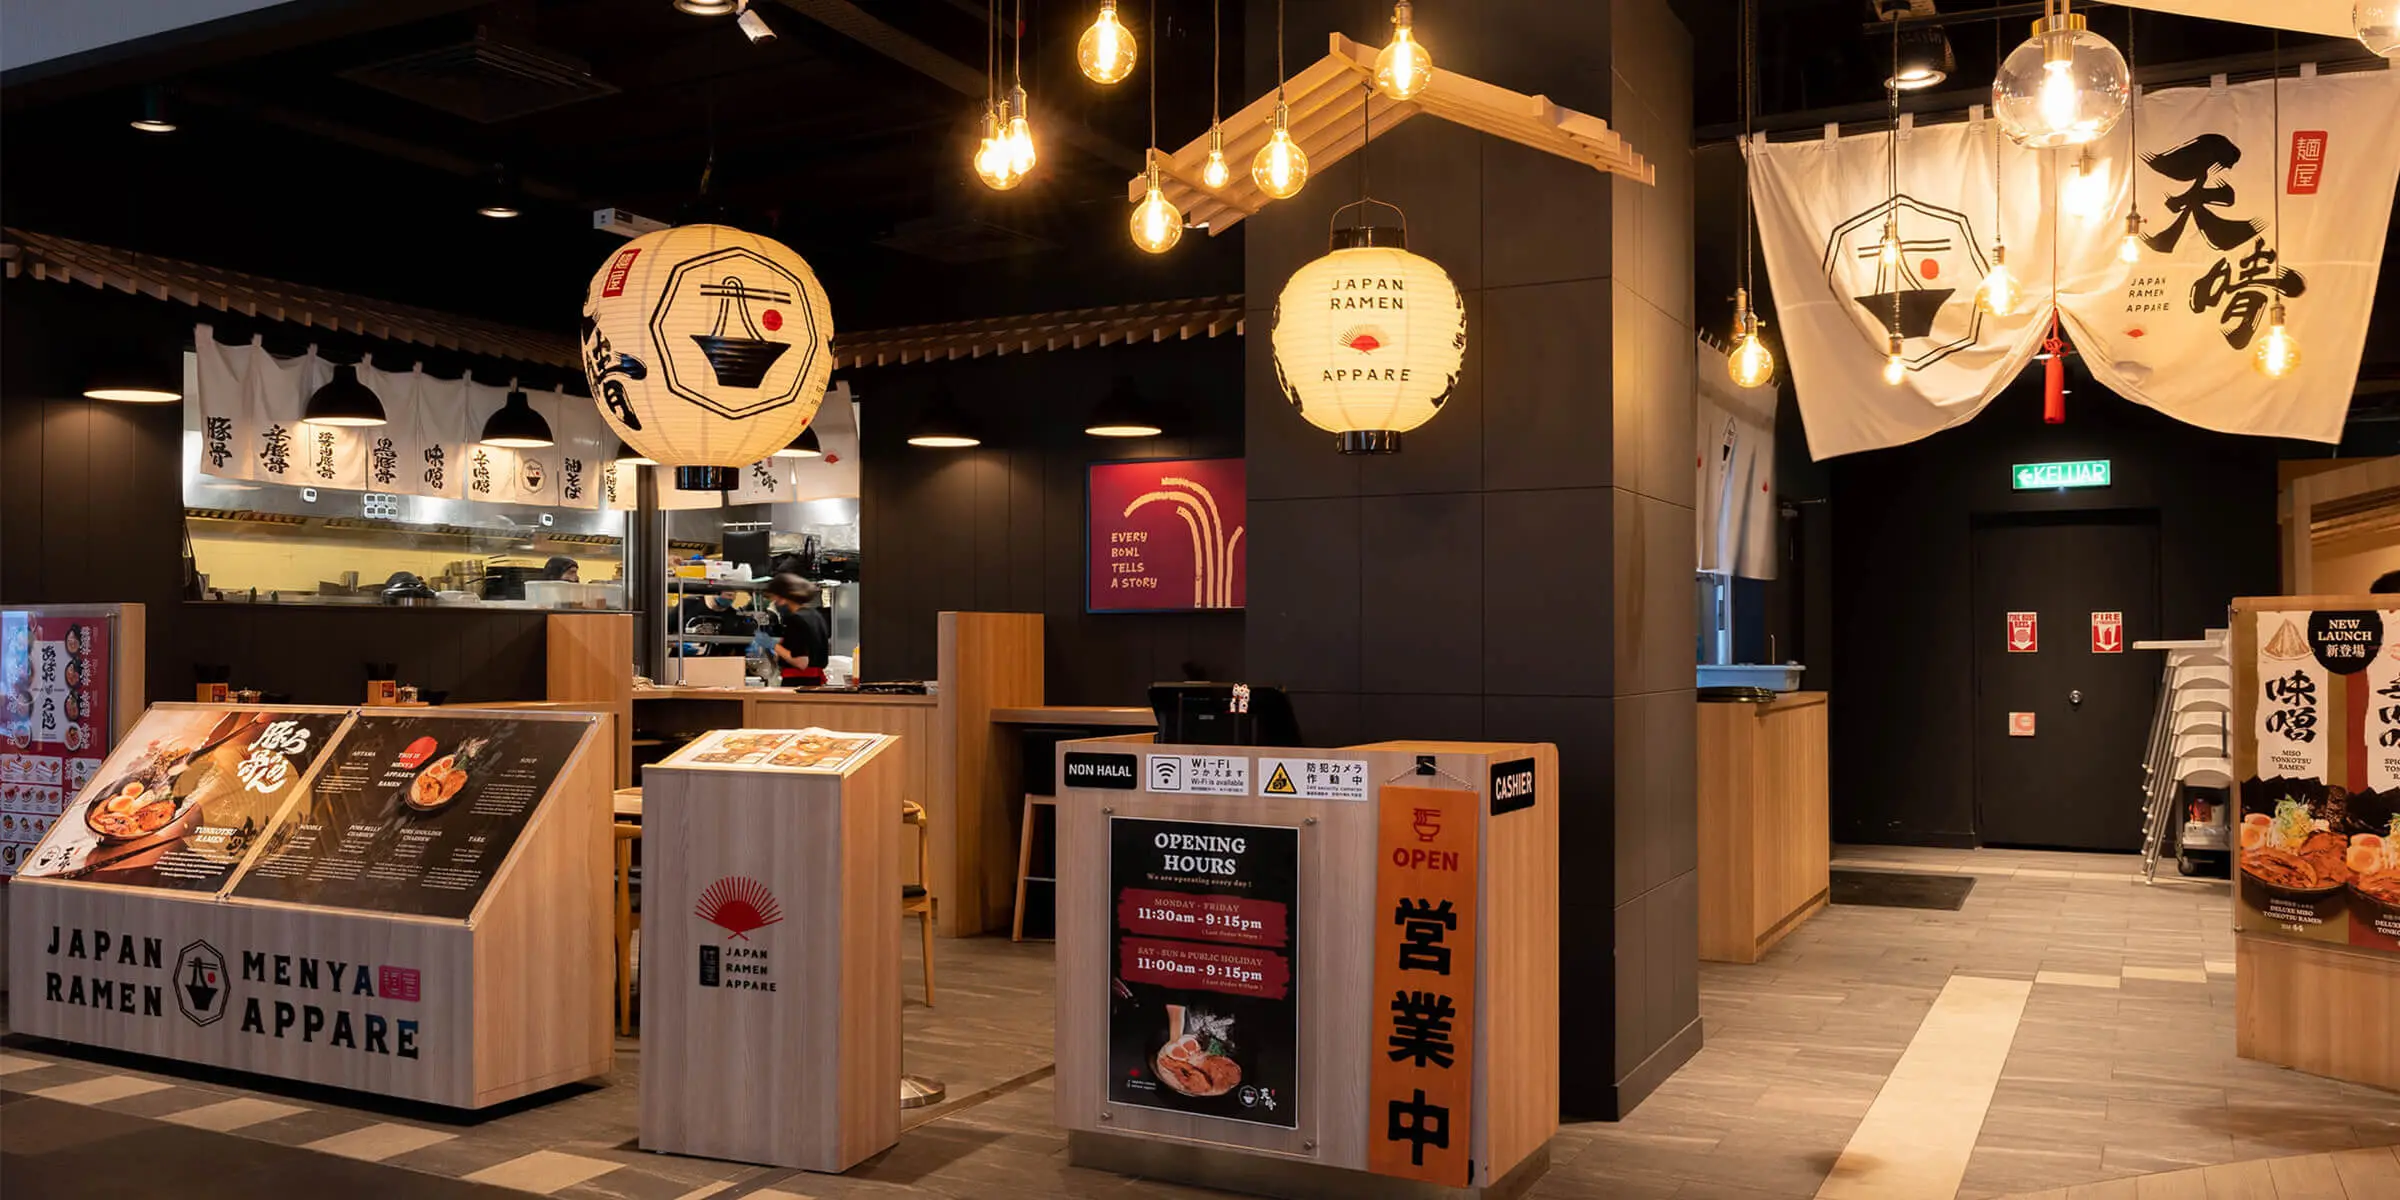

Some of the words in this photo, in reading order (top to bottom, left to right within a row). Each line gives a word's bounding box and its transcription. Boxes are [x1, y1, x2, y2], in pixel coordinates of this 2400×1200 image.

[1332, 278, 1405, 291] JAPAN
[2131, 277, 2166, 286] JAPAN
[2128, 289, 2164, 298] RAMEN
[1330, 297, 1404, 310] RAMEN
[2126, 303, 2170, 313] APPARE
[1322, 368, 1412, 382] APPARE
[207, 416, 232, 468] 豚骨
[2033, 464, 2106, 484] KELUAR
[1111, 531, 1148, 543] EVERY
[1111, 547, 1140, 558] BOWL
[1111, 562, 1145, 573] TELLS
[1110, 578, 1118, 589] A
[1121, 577, 1158, 589] STORY
[2328, 619, 2360, 630] NEW
[2317, 631, 2372, 641] LAUNCH
[2326, 644, 2366, 658] 新登場
[2264, 669, 2317, 743] 味噌
[1191, 758, 1230, 769] Wi-Fi
[2270, 756, 2312, 765] TONKOTSU
[1068, 764, 1094, 776] NON
[1097, 765, 1132, 777] HALAL
[1306, 762, 1362, 774] 防犯カメラ
[1495, 771, 1533, 800] CASHIER
[1154, 832, 1246, 854] OPENING
[1164, 854, 1237, 876] HOURS
[1392, 847, 1459, 872] OPEN
[1154, 898, 1196, 910] MONDAY
[1204, 902, 1240, 912] FRIDAY
[1138, 908, 1196, 923] 11:30am
[47, 926, 163, 969] JAPAN
[726, 946, 768, 959] JAPAN
[1188, 951, 1220, 962] PUBLIC
[1221, 955, 1264, 966] HOLIDAY
[726, 963, 768, 975] RAMEN
[1137, 958, 1196, 974] 11:00am
[242, 950, 375, 997] MENYA
[726, 978, 777, 992] APPARE
[46, 972, 163, 1017] RAMEN
[241, 998, 419, 1060] APPARE
[1387, 897, 1458, 1166] 営業中
